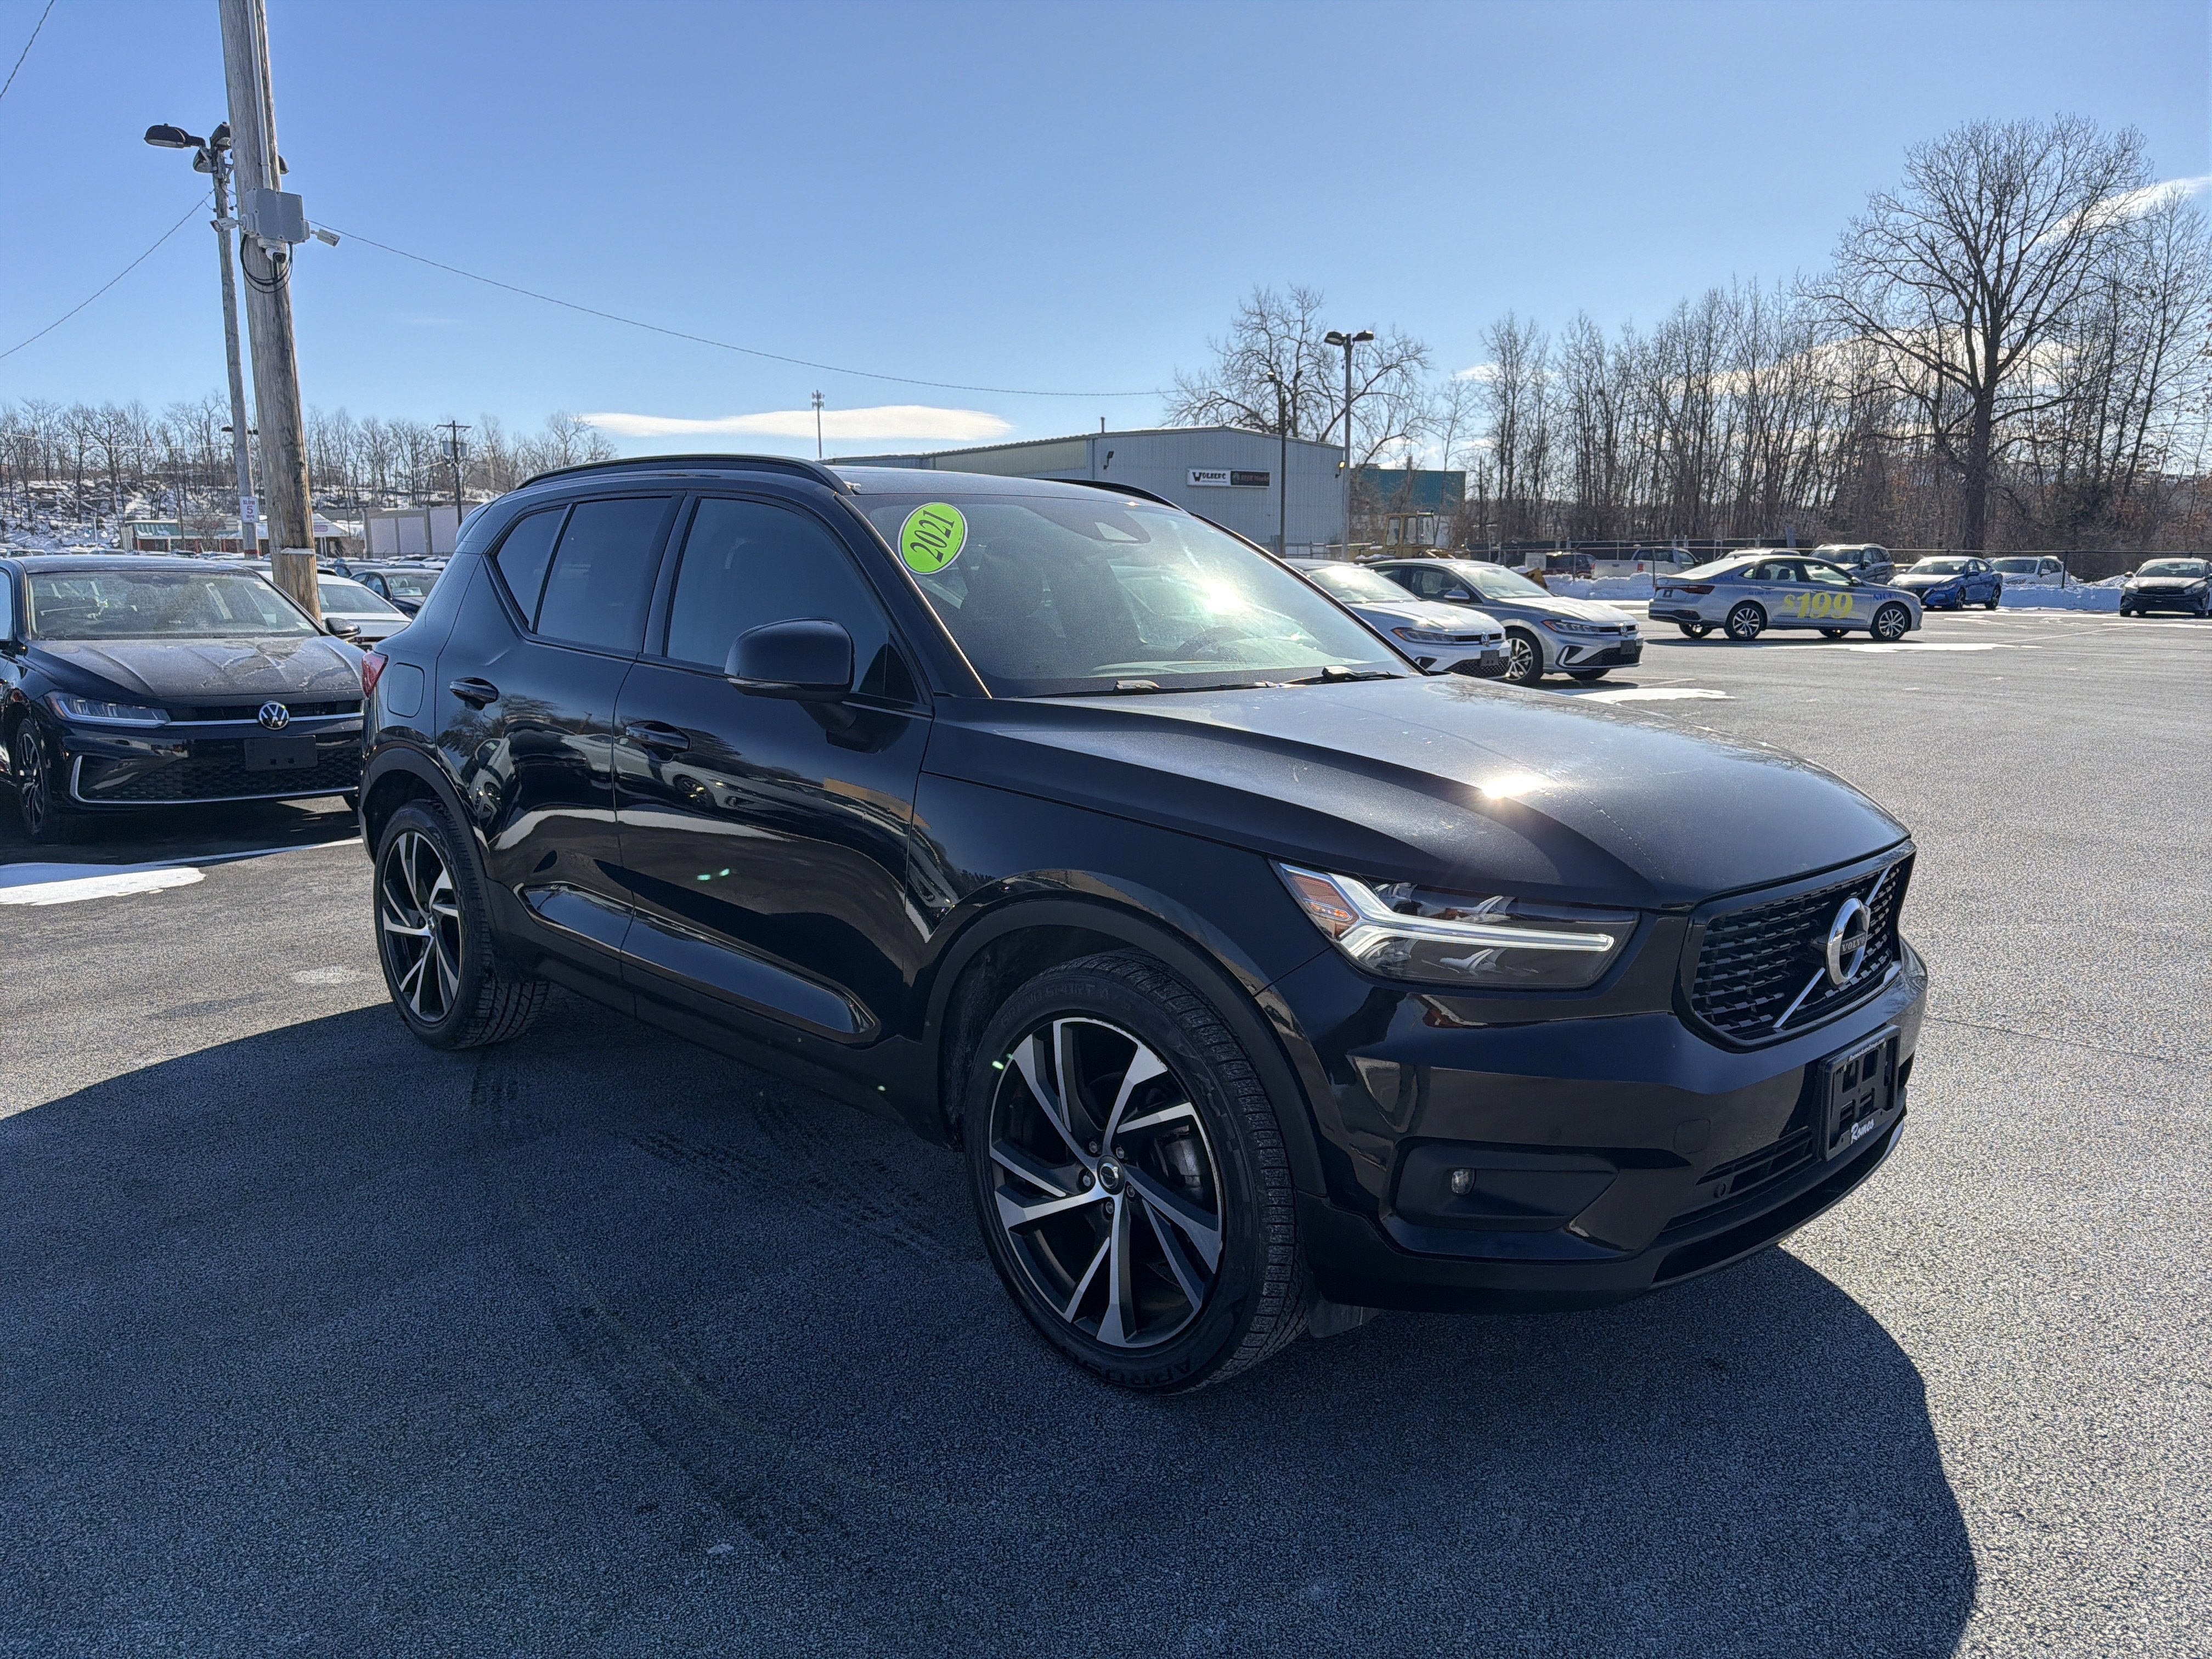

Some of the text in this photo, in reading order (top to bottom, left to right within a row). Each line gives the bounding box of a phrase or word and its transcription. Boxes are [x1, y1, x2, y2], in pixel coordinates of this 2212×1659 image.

[247, 505, 253, 515] 5
[910, 510, 955, 563] 2021
[1782, 592, 1853, 619] $199
[1841, 936, 1866, 952] VOLVO
[1850, 1118, 1875, 1145] Romeo
